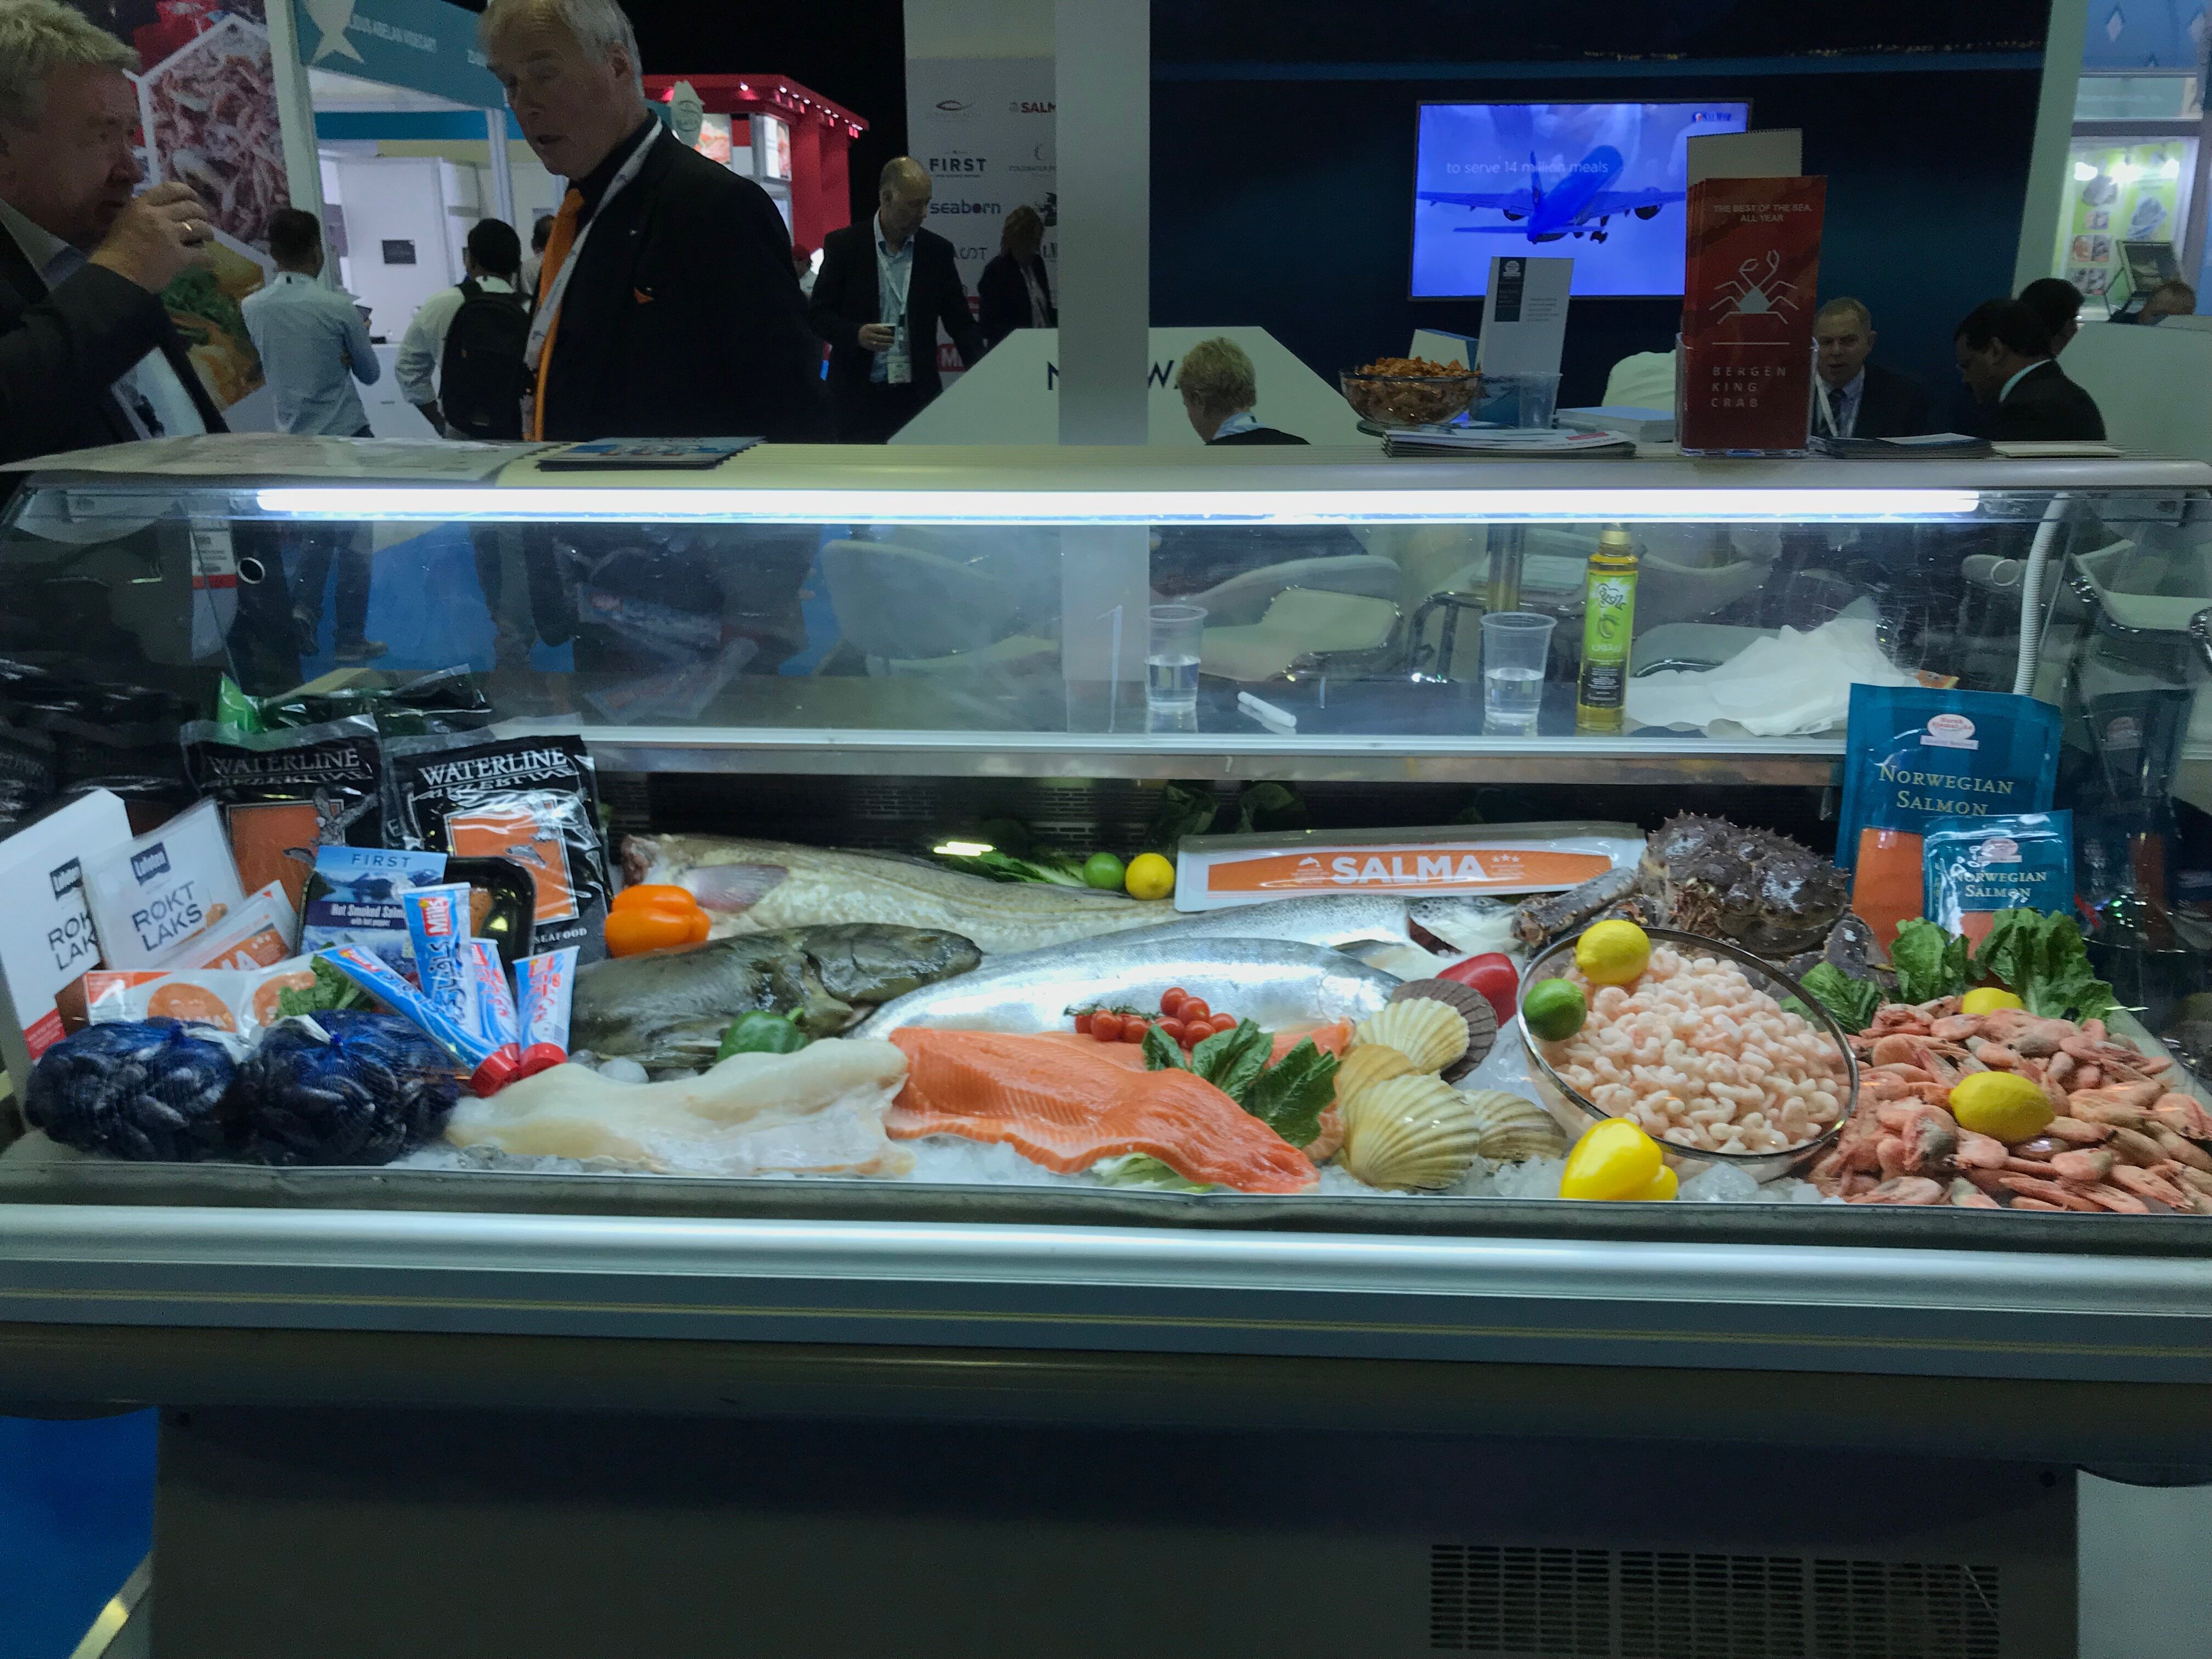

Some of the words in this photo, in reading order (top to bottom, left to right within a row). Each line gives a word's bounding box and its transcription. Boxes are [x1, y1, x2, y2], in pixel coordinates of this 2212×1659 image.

[1021, 101, 1056, 114] SALM
[929, 158, 986, 172] FIRST
[1447, 162, 1460, 173] to
[1464, 163, 1500, 173] serve
[1570, 161, 1608, 173] meals
[1740, 214, 1758, 223] ALL
[1760, 214, 1785, 223] YEAR
[1713, 366, 1786, 377] BERGEN
[1712, 382, 1757, 392] KING
[1711, 398, 1759, 408] CRAB
[208, 747, 360, 775] WATERLINE
[417, 747, 568, 787] WATERLINE
[1878, 765, 2015, 794] NORWEGIAN
[1896, 790, 1989, 816] SALMON
[352, 853, 411, 868] FIRST
[1331, 854, 1490, 885] SALMA
[1965, 884, 2032, 898] SALMON
[142, 904, 202, 952] LAKS
[55, 929, 99, 972] LAK
